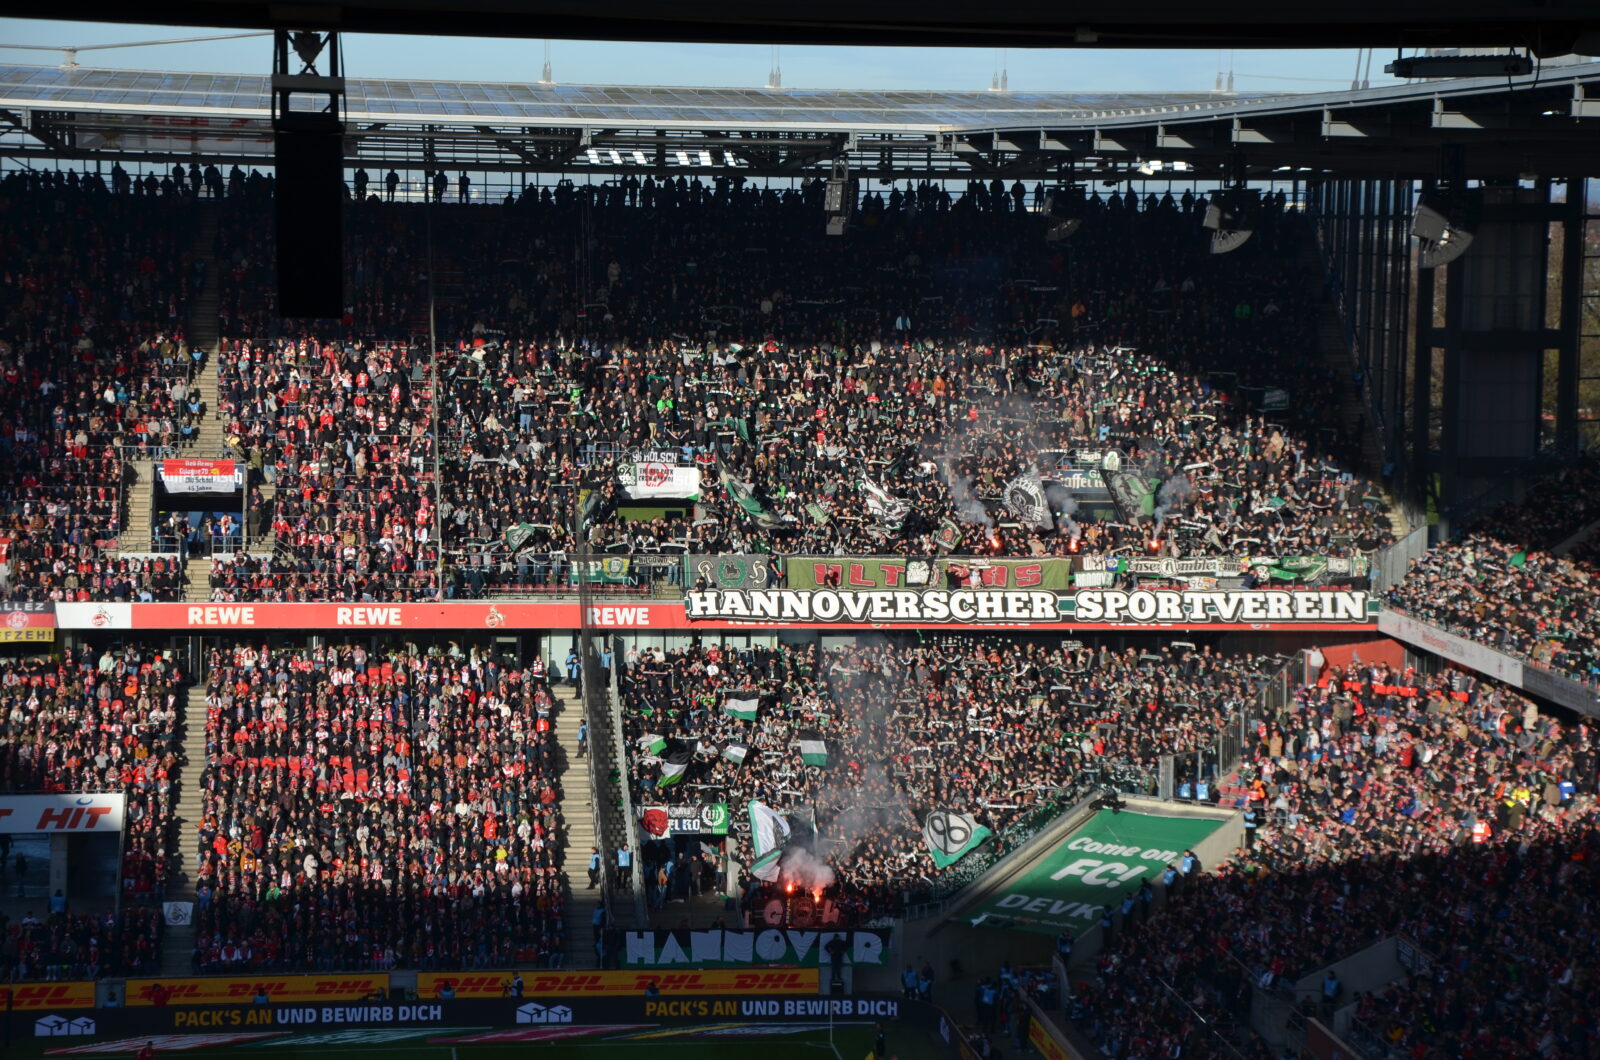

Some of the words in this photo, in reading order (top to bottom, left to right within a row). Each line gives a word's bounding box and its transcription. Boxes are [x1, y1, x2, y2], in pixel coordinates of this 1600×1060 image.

[0, 602, 45, 611] LLEZ
[688, 590, 1057, 619] HANNOVERSCHER
[1076, 590, 1366, 620] SPORTVEREIN
[187, 606, 255, 625] REWE
[336, 607, 402, 626] REWE
[586, 607, 650, 625] REWE
[36, 806, 112, 829] HIT
[930, 811, 970, 857] 96
[1067, 836, 1142, 857] Come
[1049, 858, 1149, 888] FC!
[995, 893, 1105, 920] DEVK
[228, 983, 290, 997] DHL
[315, 980, 376, 995] DHL
[432, 977, 505, 993] DHL
[534, 975, 606, 991] DHL
[633, 974, 705, 990] DHL
[733, 973, 804, 989] DHL
[245, 1008, 273, 1026] AN
[276, 1007, 317, 1025] UND
[321, 1006, 394, 1023] BEWIRB
[398, 1004, 442, 1022] DICH
[712, 1001, 738, 1016] AN
[741, 1000, 780, 1016] UND
[784, 1000, 854, 1016] BEWIRB
[858, 1000, 898, 1017] DICH
